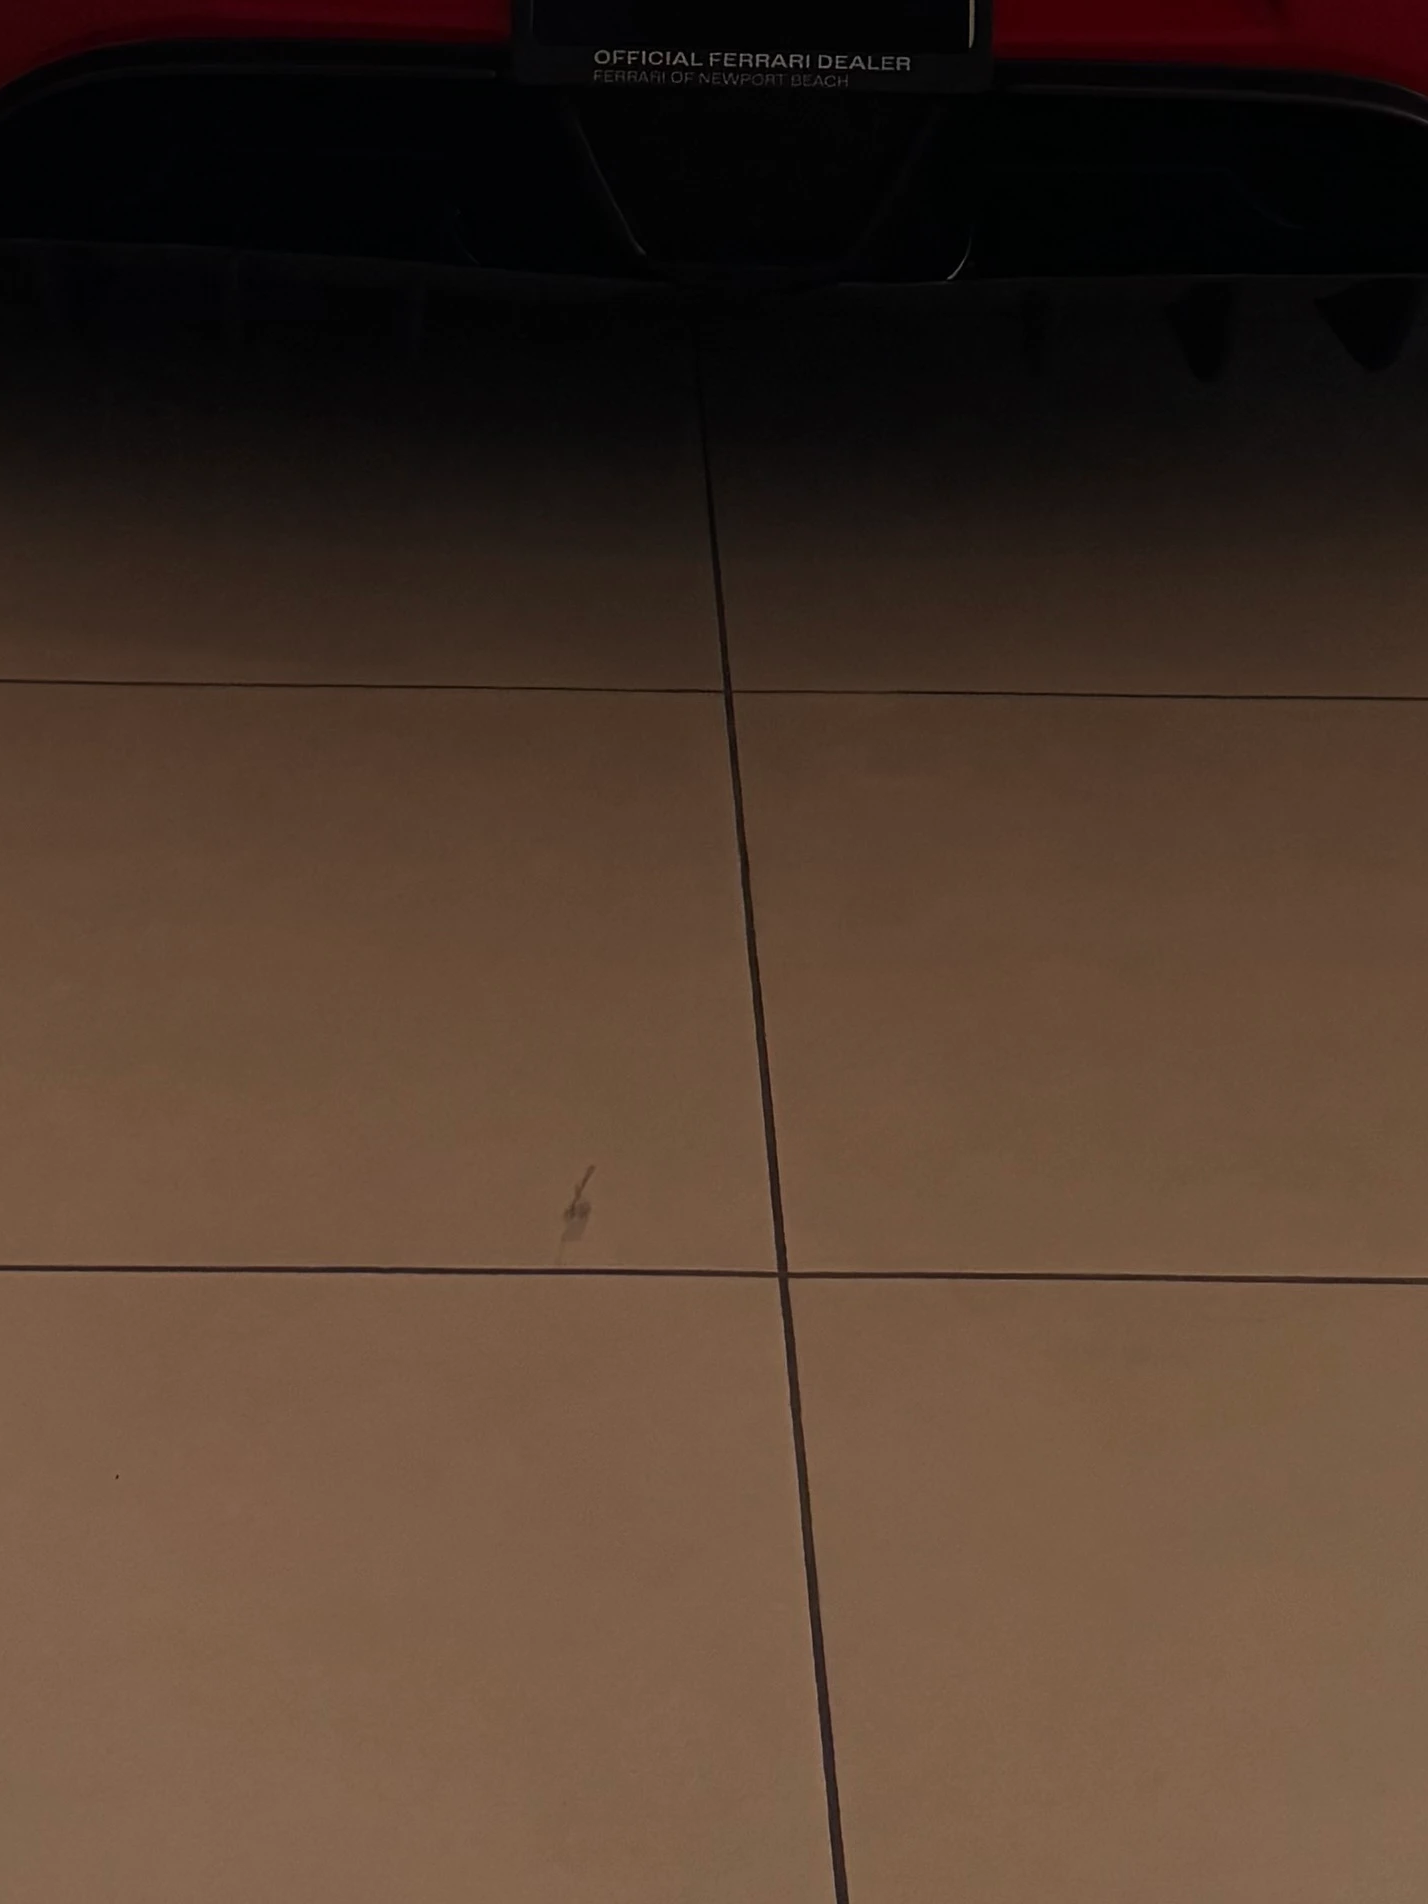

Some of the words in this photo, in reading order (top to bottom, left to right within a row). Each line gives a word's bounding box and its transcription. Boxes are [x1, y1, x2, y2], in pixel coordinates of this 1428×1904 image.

[594, 50, 704, 66] OFFICIAL
[710, 53, 811, 68] FERRARI
[818, 55, 911, 70] DEALER
[594, 70, 666, 83] FERRARI
[671, 71, 695, 83] OF
[699, 72, 784, 85] NEWPORT
[791, 74, 849, 87] BEACH
